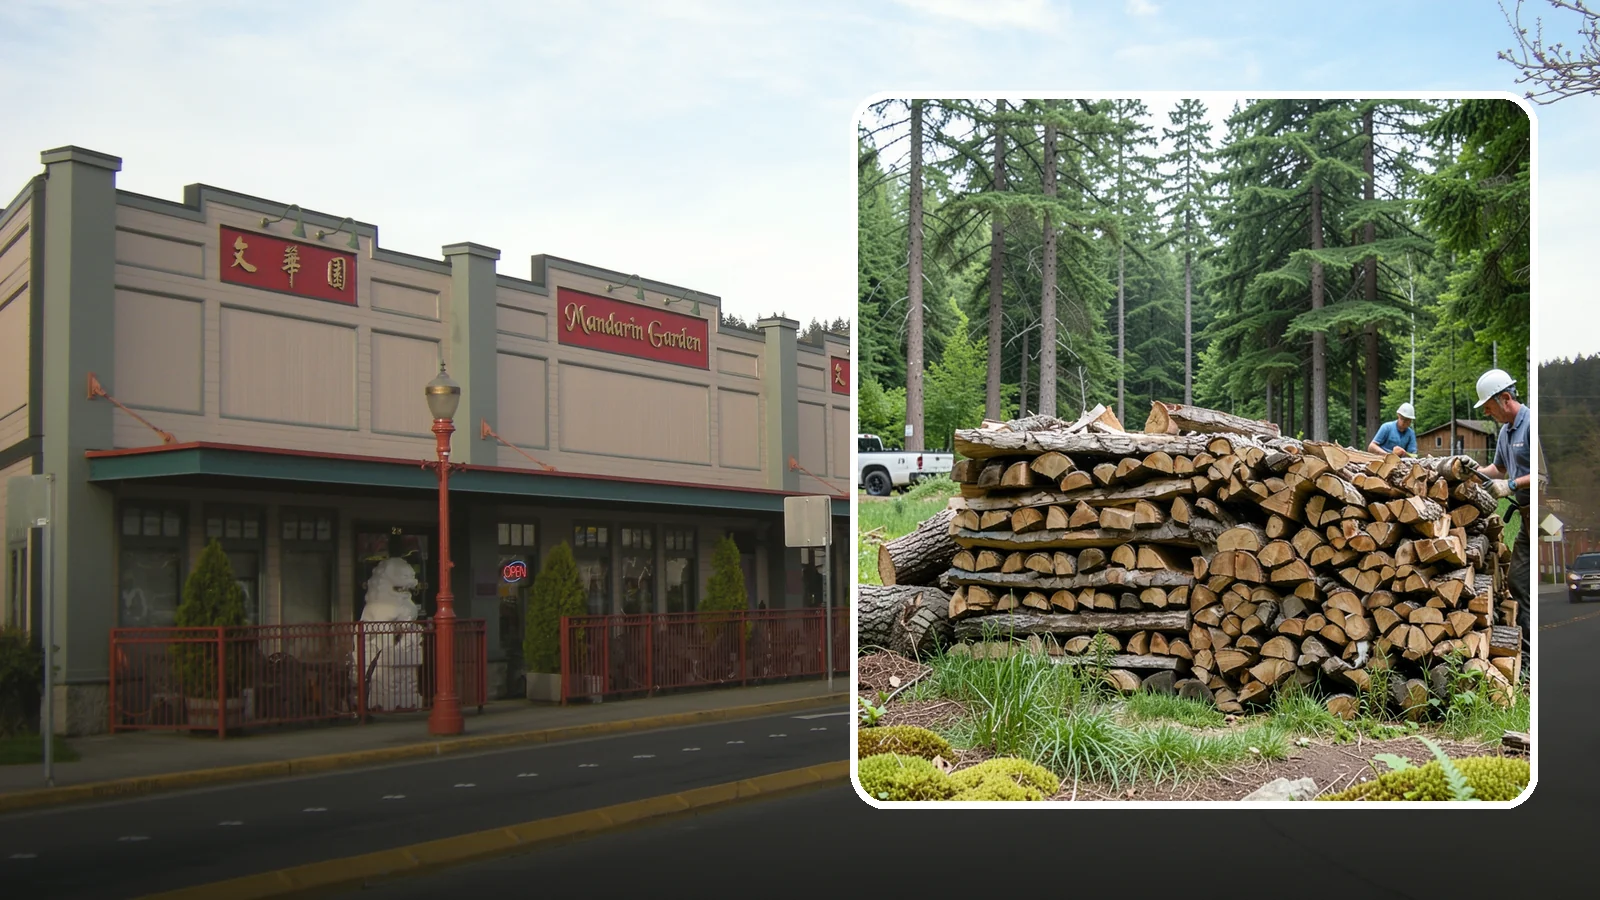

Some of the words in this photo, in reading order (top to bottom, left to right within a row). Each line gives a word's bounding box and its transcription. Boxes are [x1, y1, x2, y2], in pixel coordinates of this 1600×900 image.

[230, 235, 346, 291] 文華園
[564, 302, 644, 341] Mandarin
[648, 320, 702, 352] Garden
[503, 565, 527, 578] OPEN
